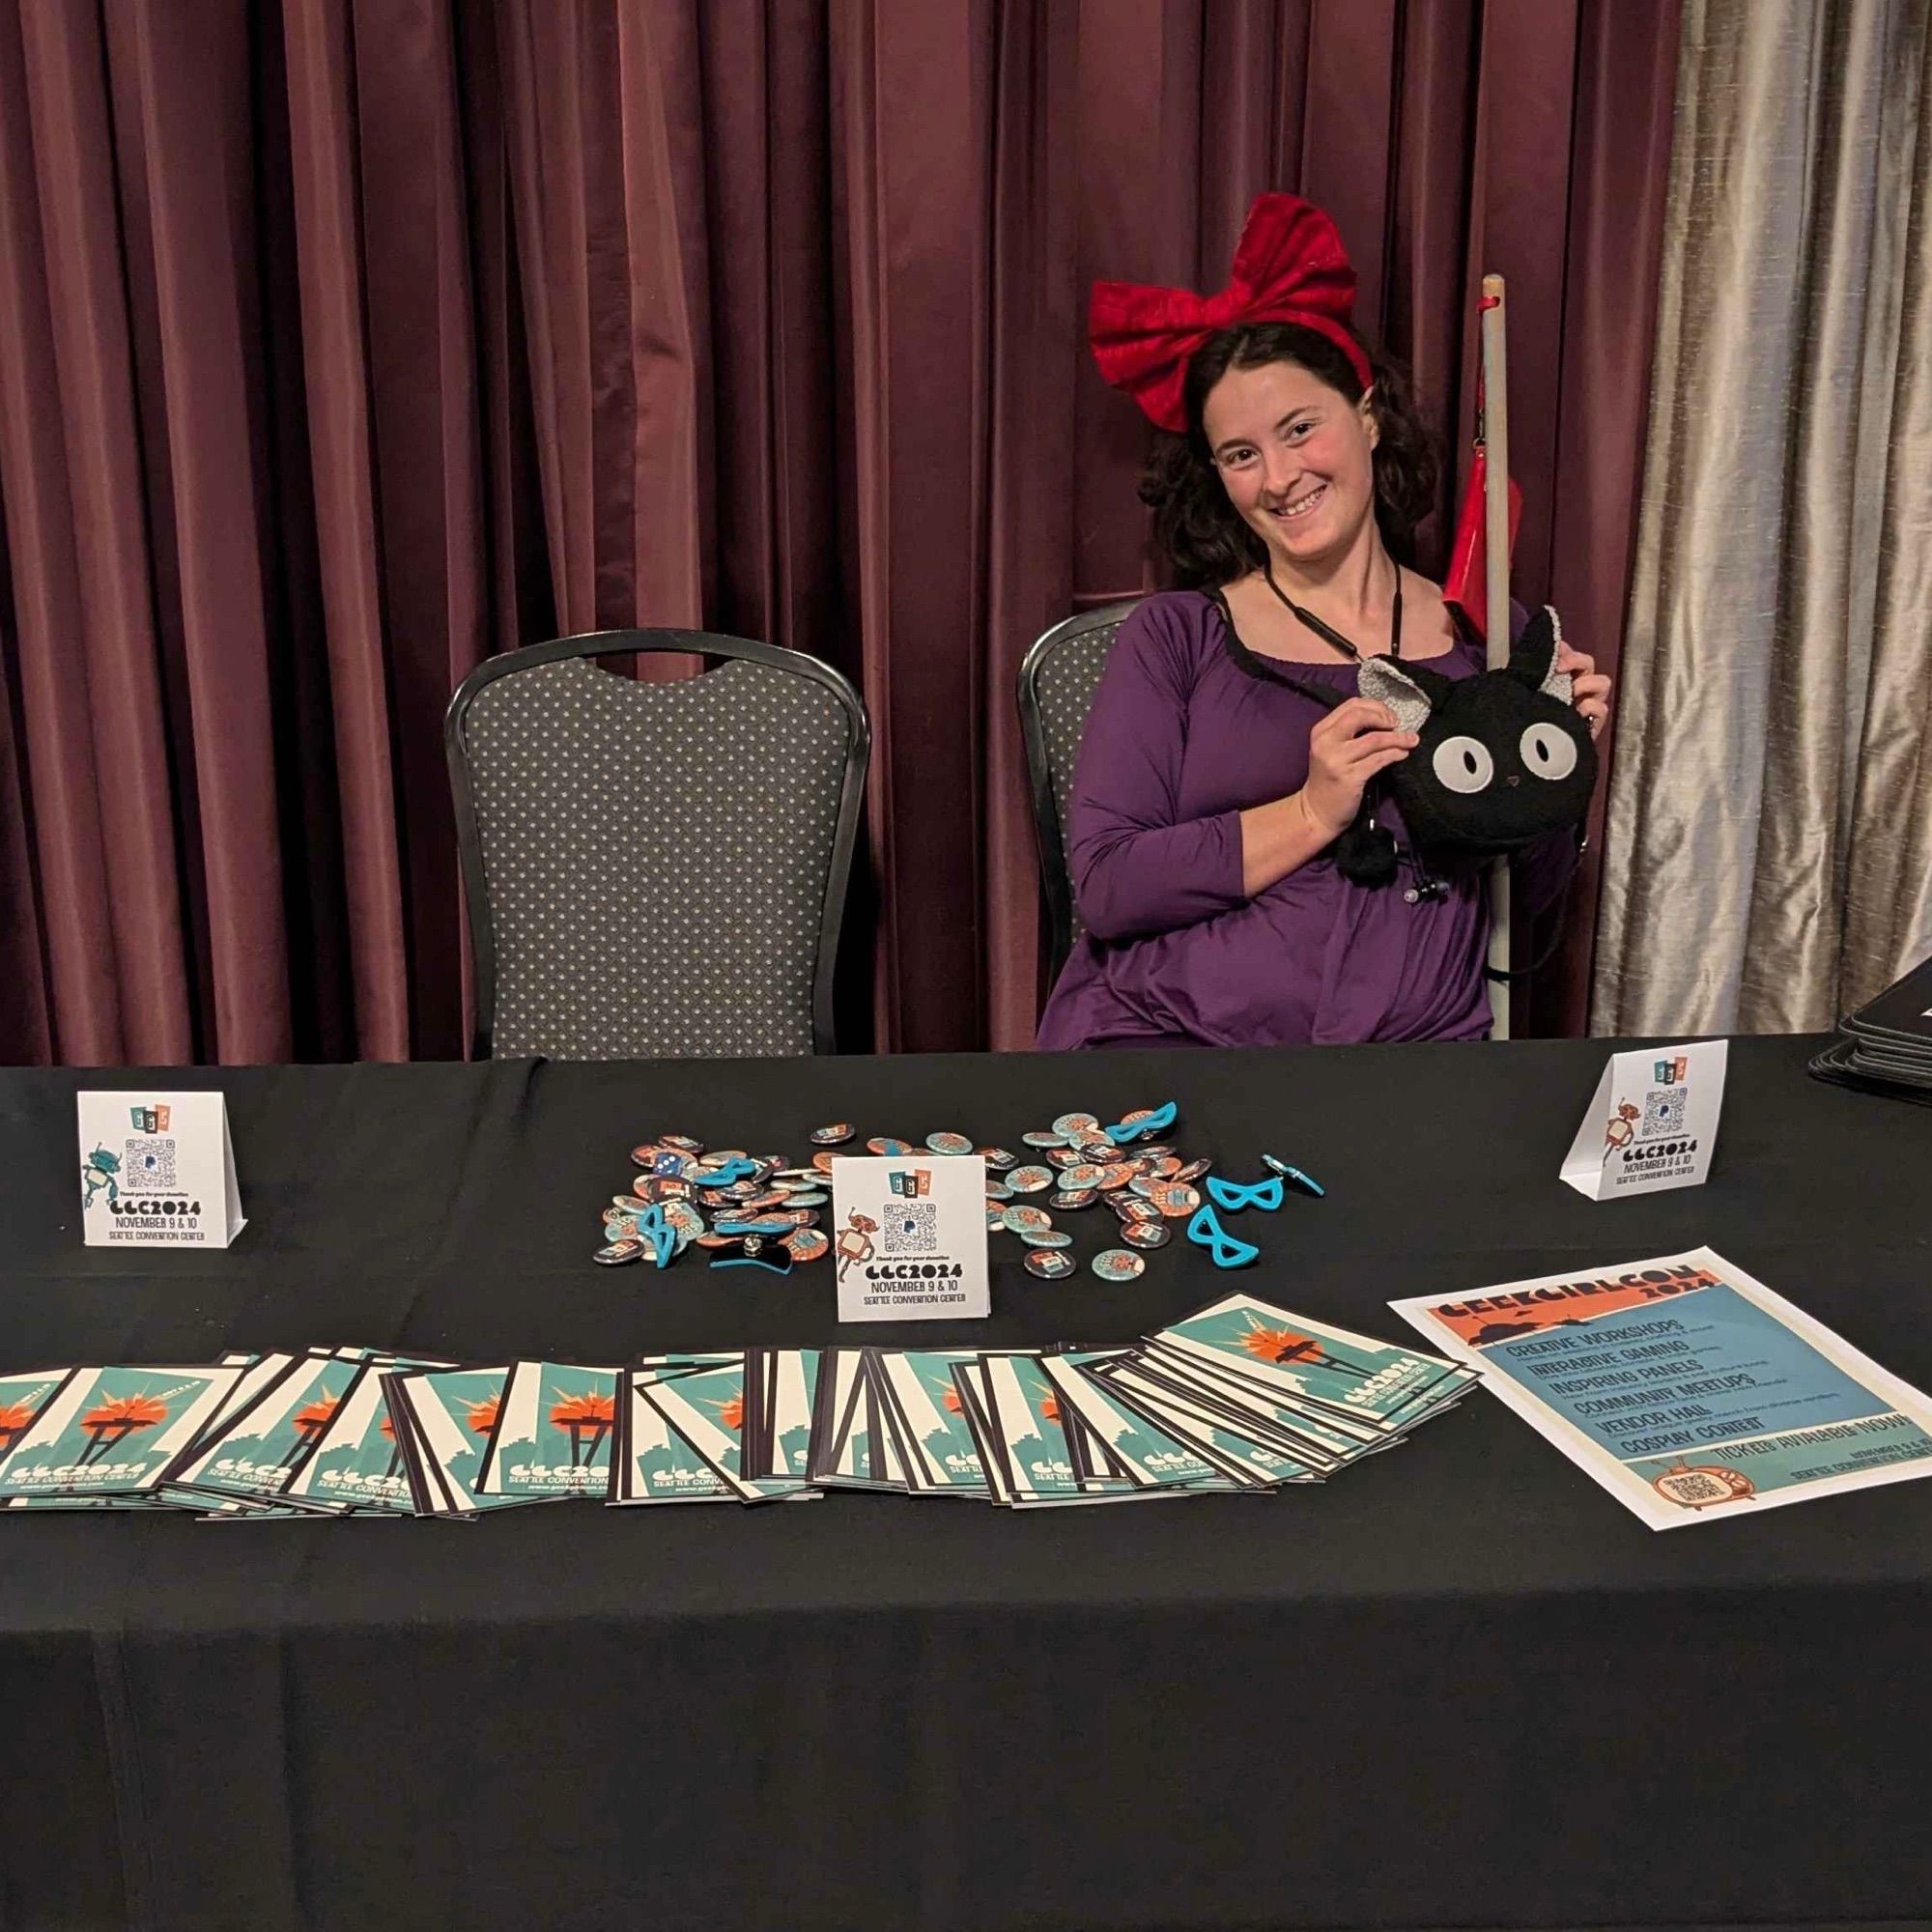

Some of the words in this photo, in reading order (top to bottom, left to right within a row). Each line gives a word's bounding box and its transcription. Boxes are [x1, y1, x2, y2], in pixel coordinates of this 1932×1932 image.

[1624, 1158, 1665, 1174] NOVEMBER
[1667, 1157, 1673, 1167] 9
[1675, 1156, 1681, 1166] &
[1683, 1154, 1691, 1165] 10
[116, 1217, 166, 1229] NOVEMBER
[168, 1217, 176, 1229] 9
[178, 1217, 185, 1229] &
[187, 1217, 197, 1229] 10
[108, 1232, 133, 1240] SEATTLE
[135, 1232, 179, 1240] CONVENTION
[864, 1296, 890, 1305] SEATTLE
[893, 1294, 938, 1304] CONVENTION
[940, 1293, 966, 1302] CENTER
[871, 1281, 925, 1293] NOVEMBER
[927, 1281, 935, 1293] 9
[937, 1280, 945, 1292] &
[948, 1280, 958, 1291] 10
[1438, 1264, 1700, 1318] GEEKGIRLCON
[1639, 1277, 1715, 1299] 2024
[1506, 1336, 1576, 1357] CREATIVE
[1578, 1320, 1685, 1346] WORKSHOPS
[1527, 1352, 1622, 1376] INTERACTIVE
[1619, 1341, 1690, 1360] GAMING
[1549, 1370, 1638, 1395] INSPIRING
[1636, 1359, 1704, 1379] PANELS
[1574, 1387, 1677, 1414] COMMUNITY
[1675, 1373, 1756, 1397] MEETUPS
[1596, 1412, 1669, 1434] VENDOR
[1669, 1405, 1713, 1422] HALL
[1620, 1430, 1694, 1453] COSPLAY
[1696, 1417, 1765, 1438] CONTEST
[1711, 1439, 1776, 1461] TICKETS
[1855, 1413, 1913, 1434] NOW!
[510, 1464, 609, 1477] GGC20
[317, 1480, 353, 1491] SEATTLE
